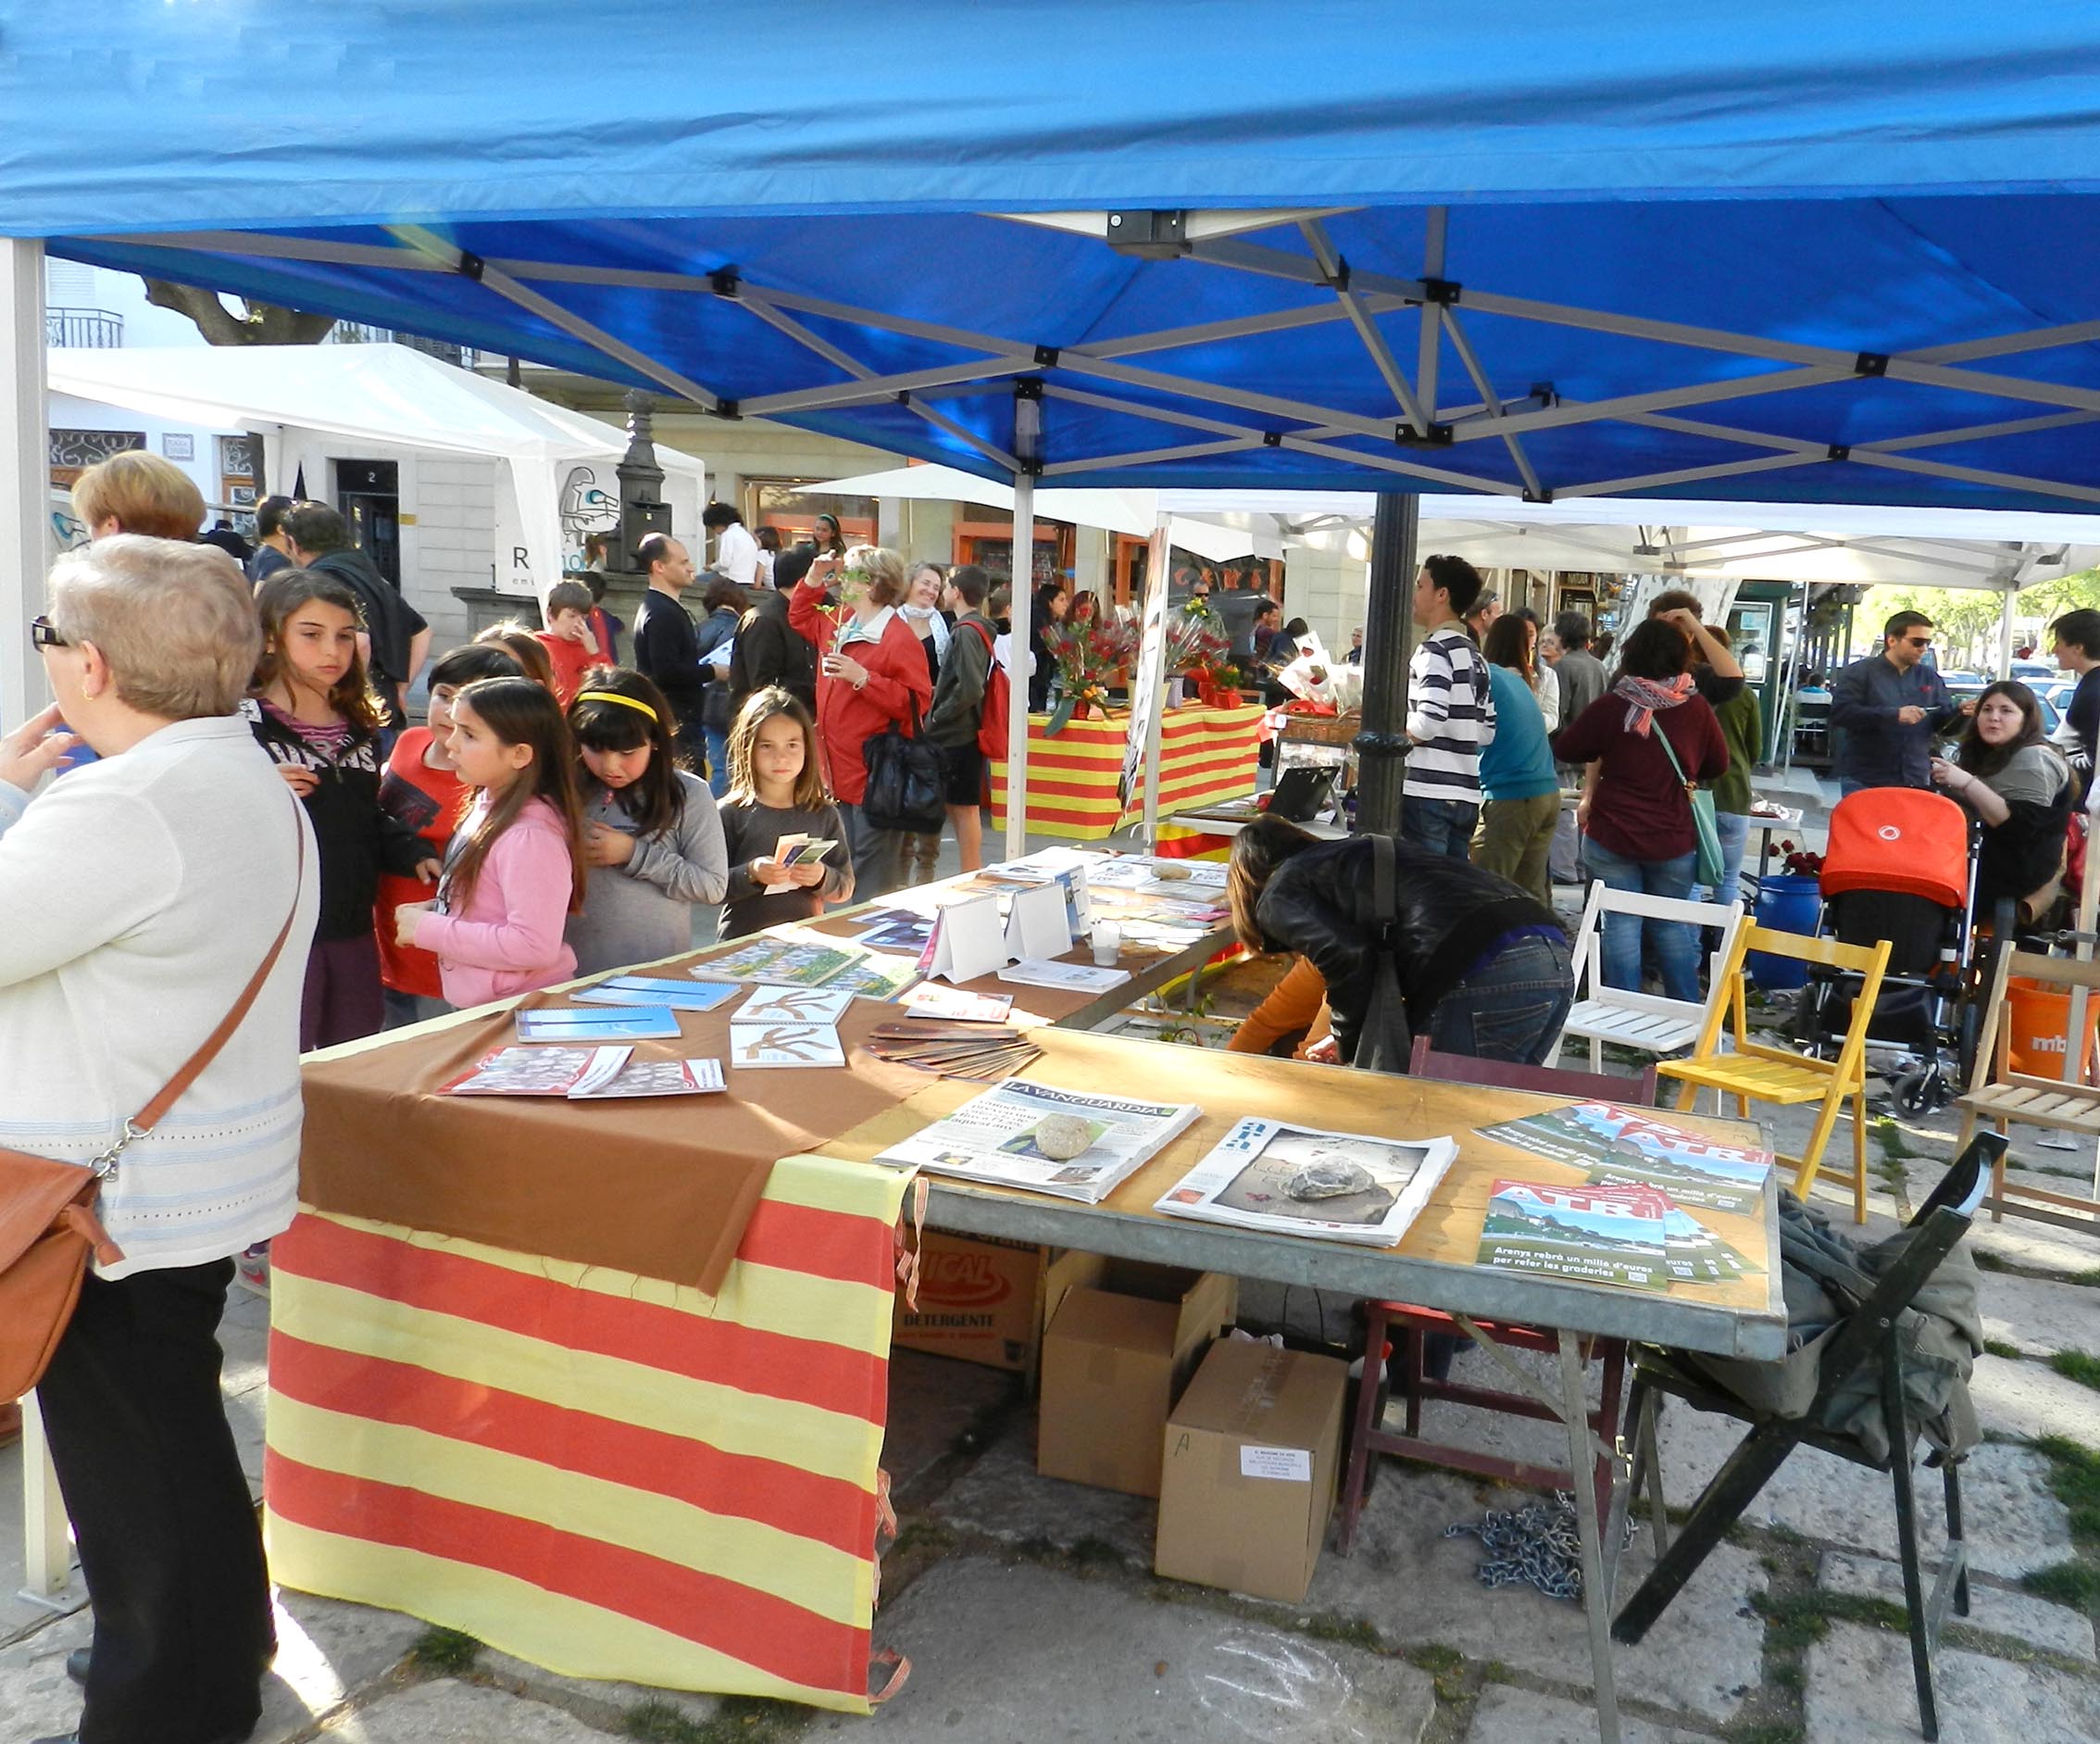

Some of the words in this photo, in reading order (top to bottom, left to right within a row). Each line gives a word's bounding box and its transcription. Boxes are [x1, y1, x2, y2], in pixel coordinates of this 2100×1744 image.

[369, 471, 376, 483] 2
[1006, 1082, 1031, 1092] LA
[1033, 1087, 1159, 1115] VANGUARDIA
[1493, 1257, 1513, 1265] per
[1514, 1258, 1542, 1268] refer
[1544, 1261, 1559, 1270] les
[1561, 1264, 1615, 1277] graderies
[1494, 1247, 1531, 1258] Arenys
[1533, 1251, 1564, 1261] rebrà
[1612, 1261, 1654, 1273] d'euros
[904, 1312, 994, 1328] DETERGENTE
